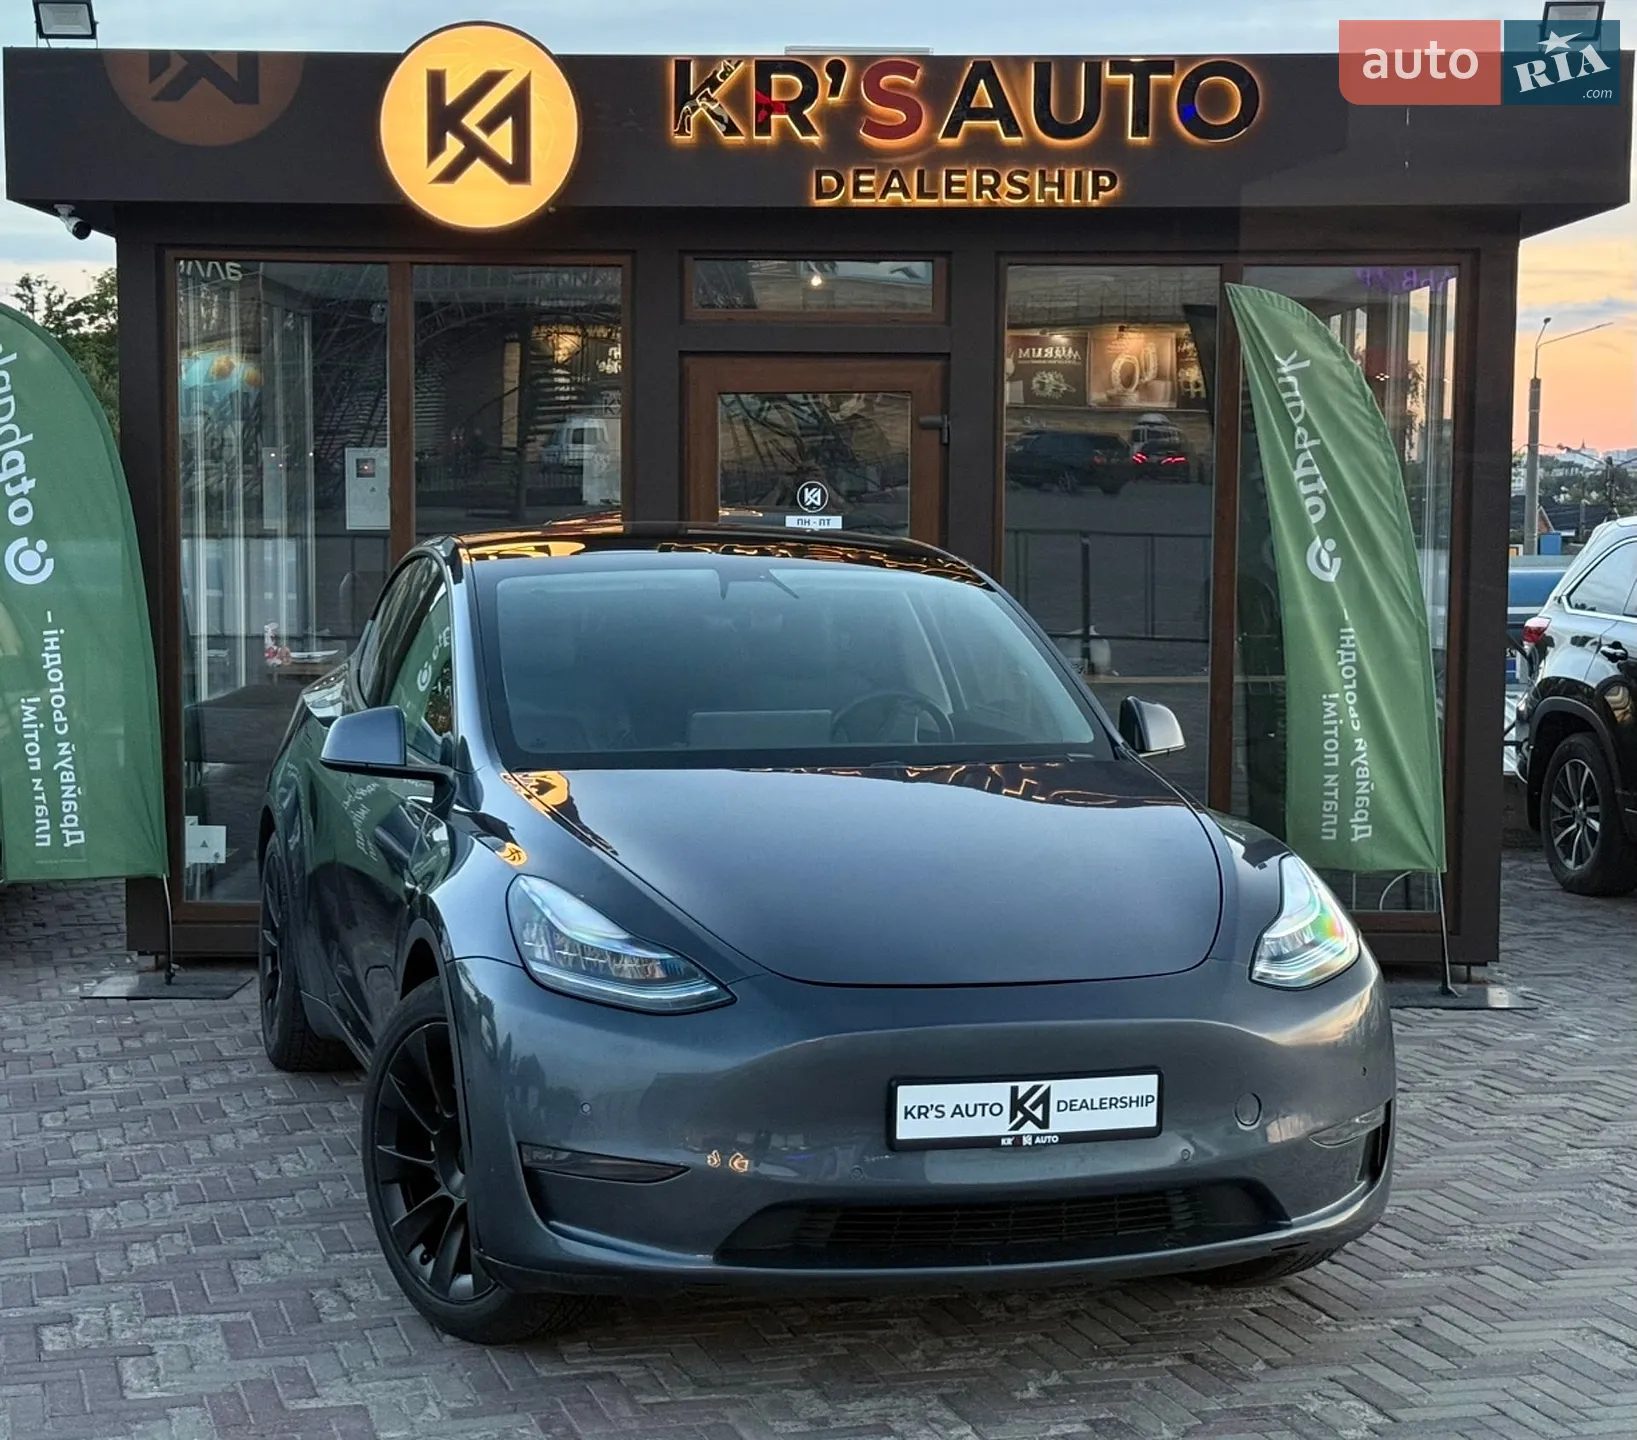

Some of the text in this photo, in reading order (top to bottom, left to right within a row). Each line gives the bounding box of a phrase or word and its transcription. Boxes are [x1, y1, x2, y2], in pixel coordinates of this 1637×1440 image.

[673, 58, 1261, 142] KR'S AUTO
[813, 167, 1118, 203] DEALERSHIP
[903, 1103, 946, 1120] KR'S
[950, 1101, 1004, 1119] AUTO
[1056, 1094, 1155, 1113] DEALERSHIP
[1034, 1134, 1059, 1144] AUTO
